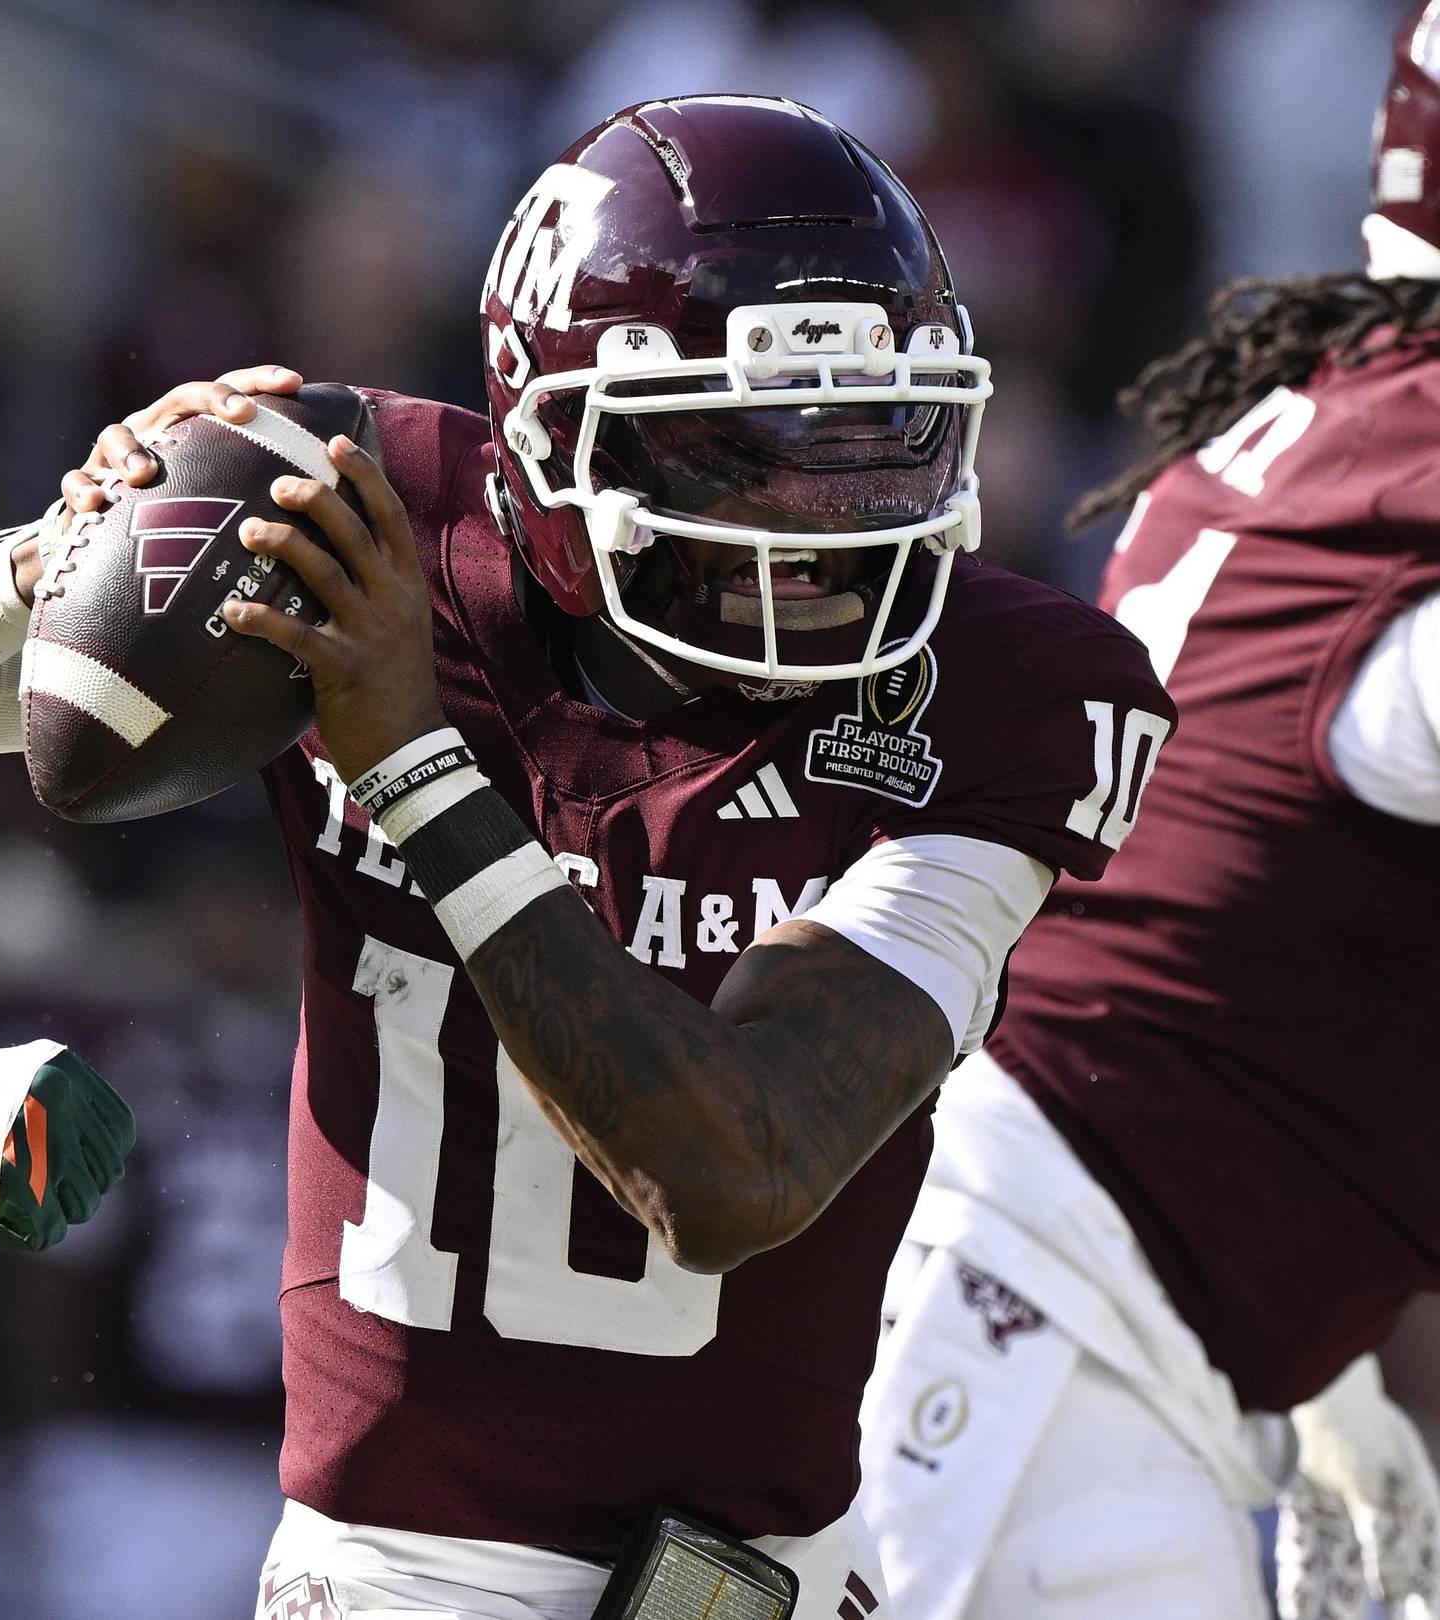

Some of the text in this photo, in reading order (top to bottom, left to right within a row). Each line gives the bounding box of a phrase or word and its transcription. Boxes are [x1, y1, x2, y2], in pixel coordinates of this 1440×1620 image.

[791, 318, 842, 344] Aggies
[841, 723, 921, 757] PLAYOFF
[816, 738, 932, 781] FIRST ROUND
[825, 761, 916, 794] PRESENTED BY Allstate
[1065, 700, 1171, 852] 10
[372, 793, 386, 809] OF
[383, 777, 409, 798] THE
[406, 765, 438, 784] 12TH
